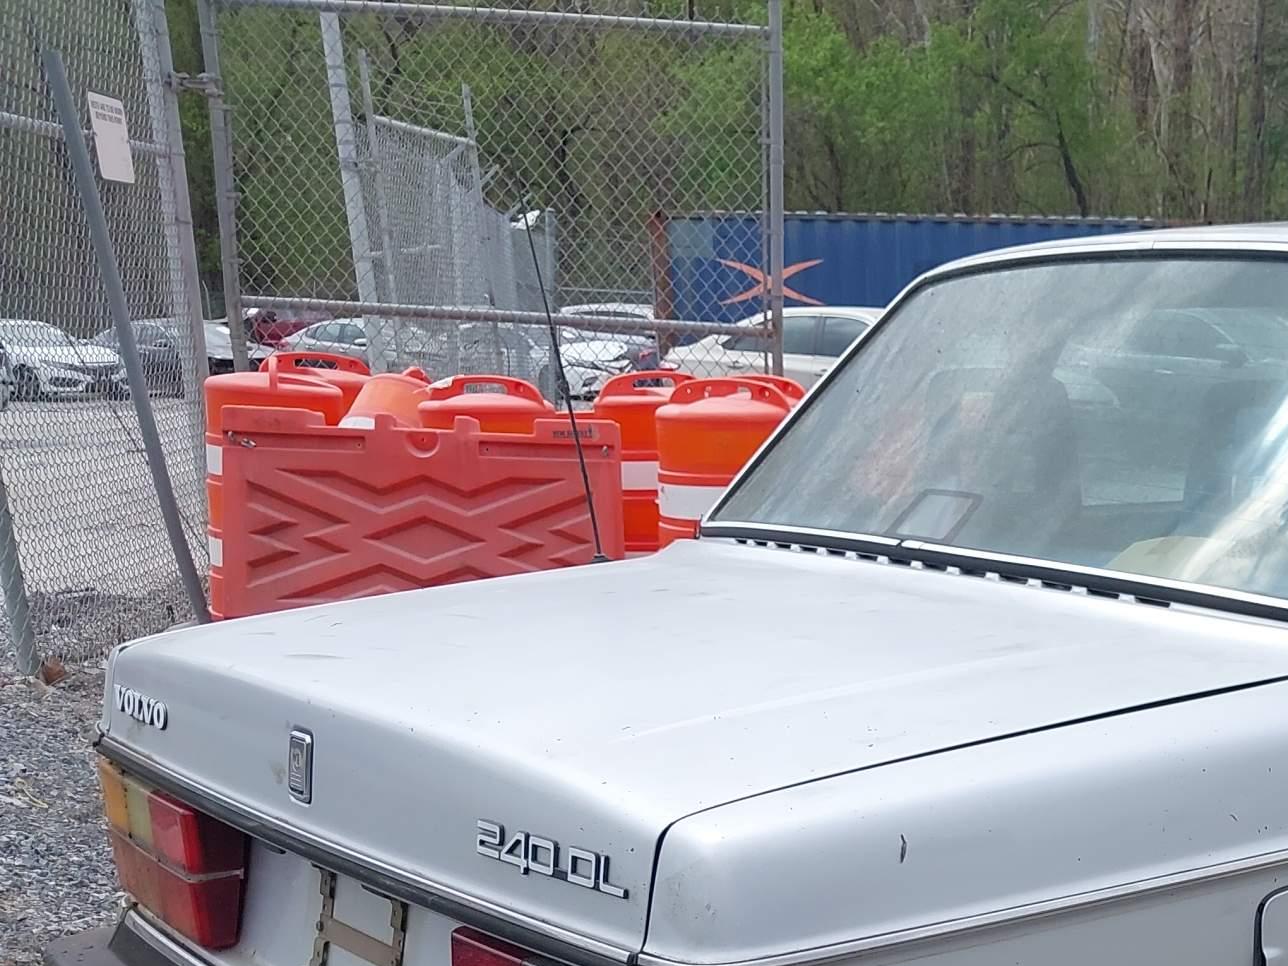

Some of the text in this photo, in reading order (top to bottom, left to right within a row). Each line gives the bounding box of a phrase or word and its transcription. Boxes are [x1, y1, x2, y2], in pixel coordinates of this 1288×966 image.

[114, 684, 168, 730] VOLVO
[476, 819, 629, 899] 240 DL
